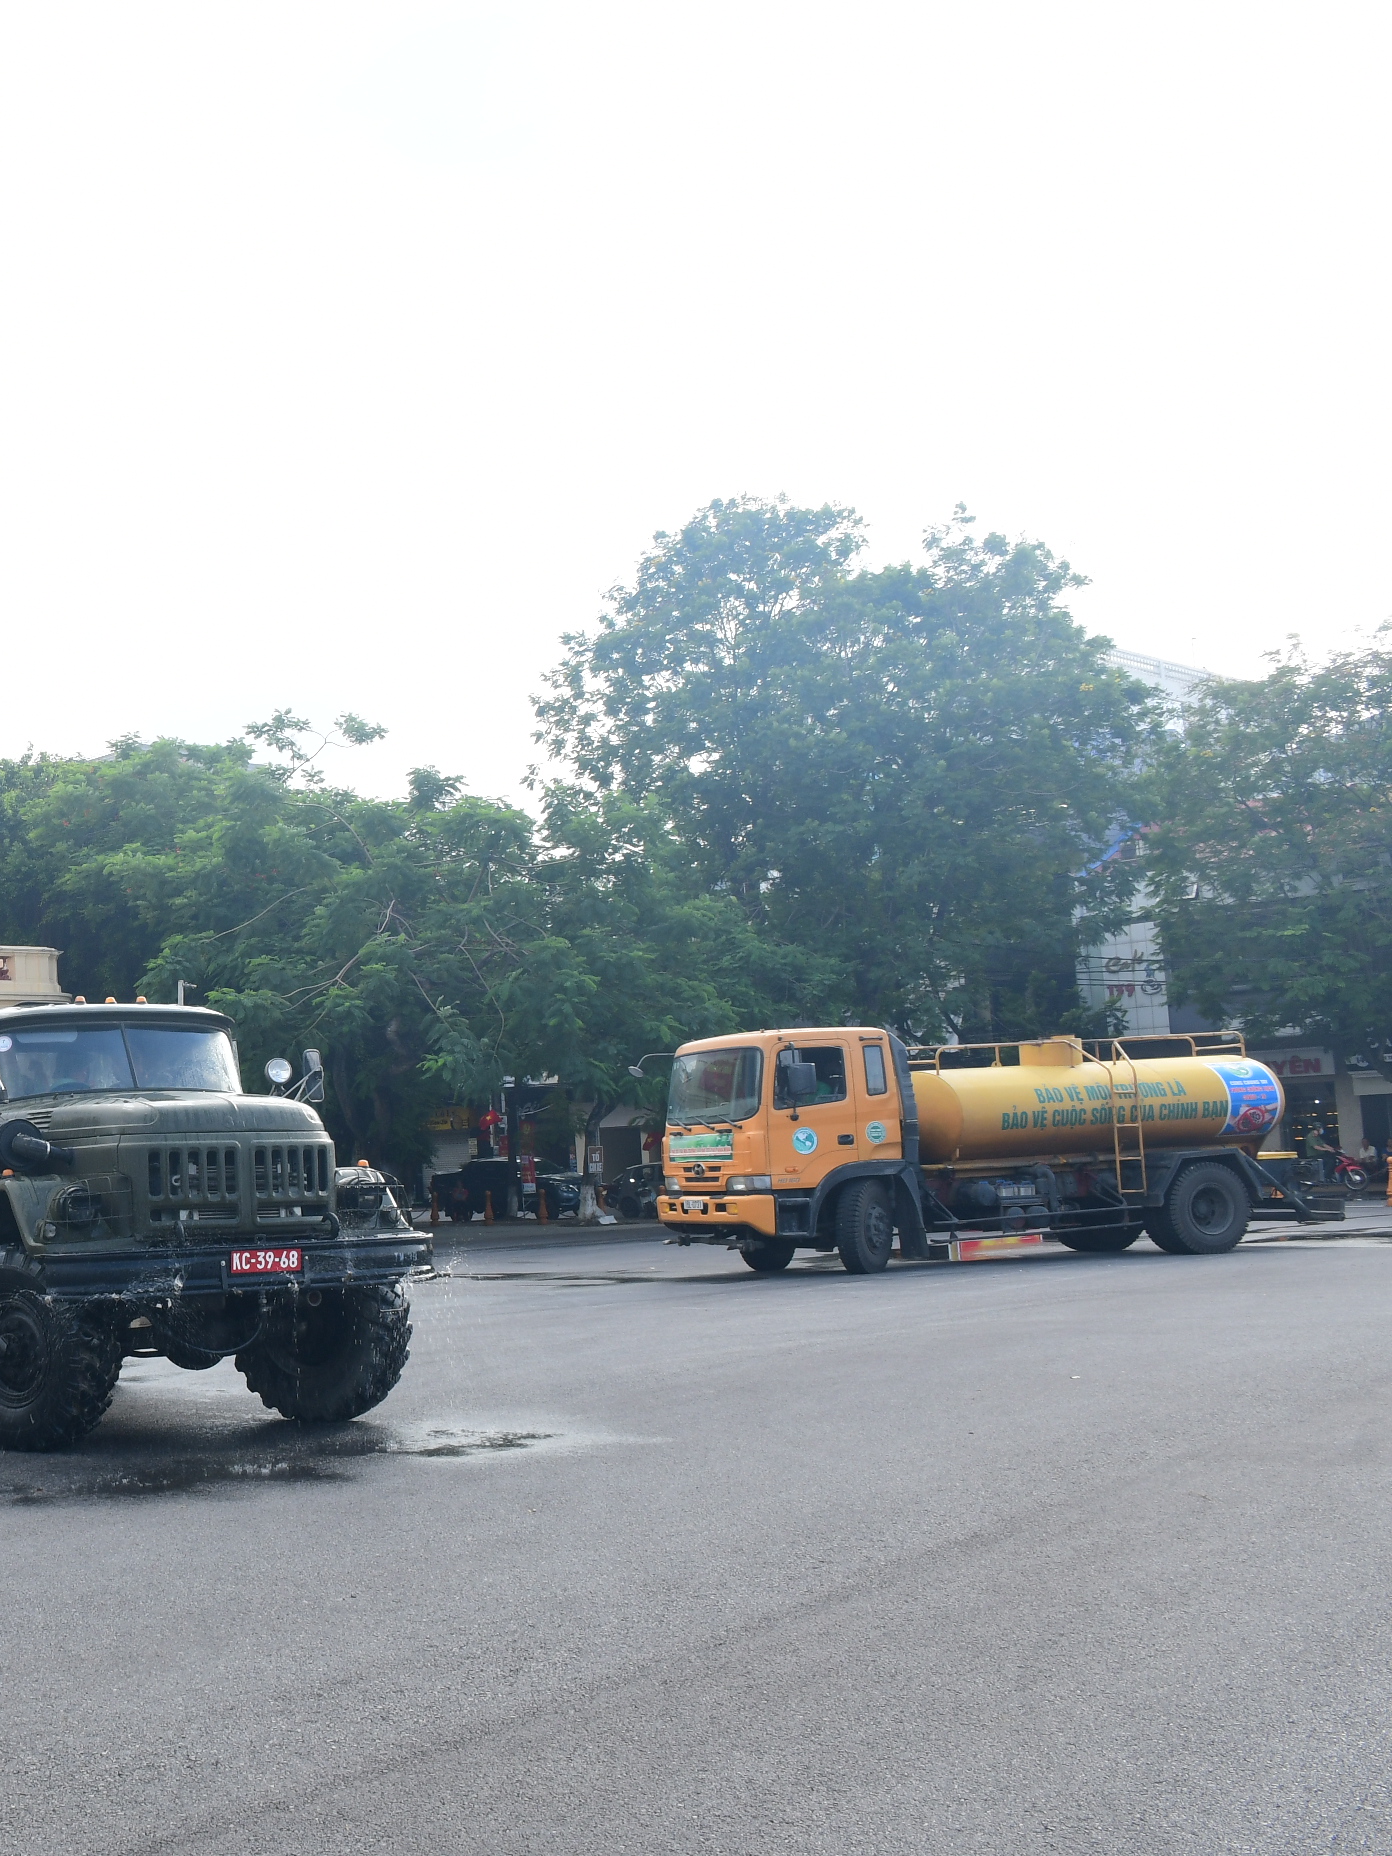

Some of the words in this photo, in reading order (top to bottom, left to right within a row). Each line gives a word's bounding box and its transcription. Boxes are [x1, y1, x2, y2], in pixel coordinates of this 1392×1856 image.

[1034, 1083, 1064, 1104] BẢO
[1064, 1083, 1084, 1104] VỆ
[1083, 1082, 1112, 1101] MÔI
[1167, 1078, 1187, 1096] LÀ
[1002, 1105, 1028, 1130] BẢO
[1032, 1106, 1048, 1131] VỆ
[1052, 1104, 1087, 1130] CUỘC
[1159, 1098, 1198, 1121] CHÍNH
[1202, 1100, 1228, 1121] BẠN
[232, 1250, 298, 1271] KC-39-68
